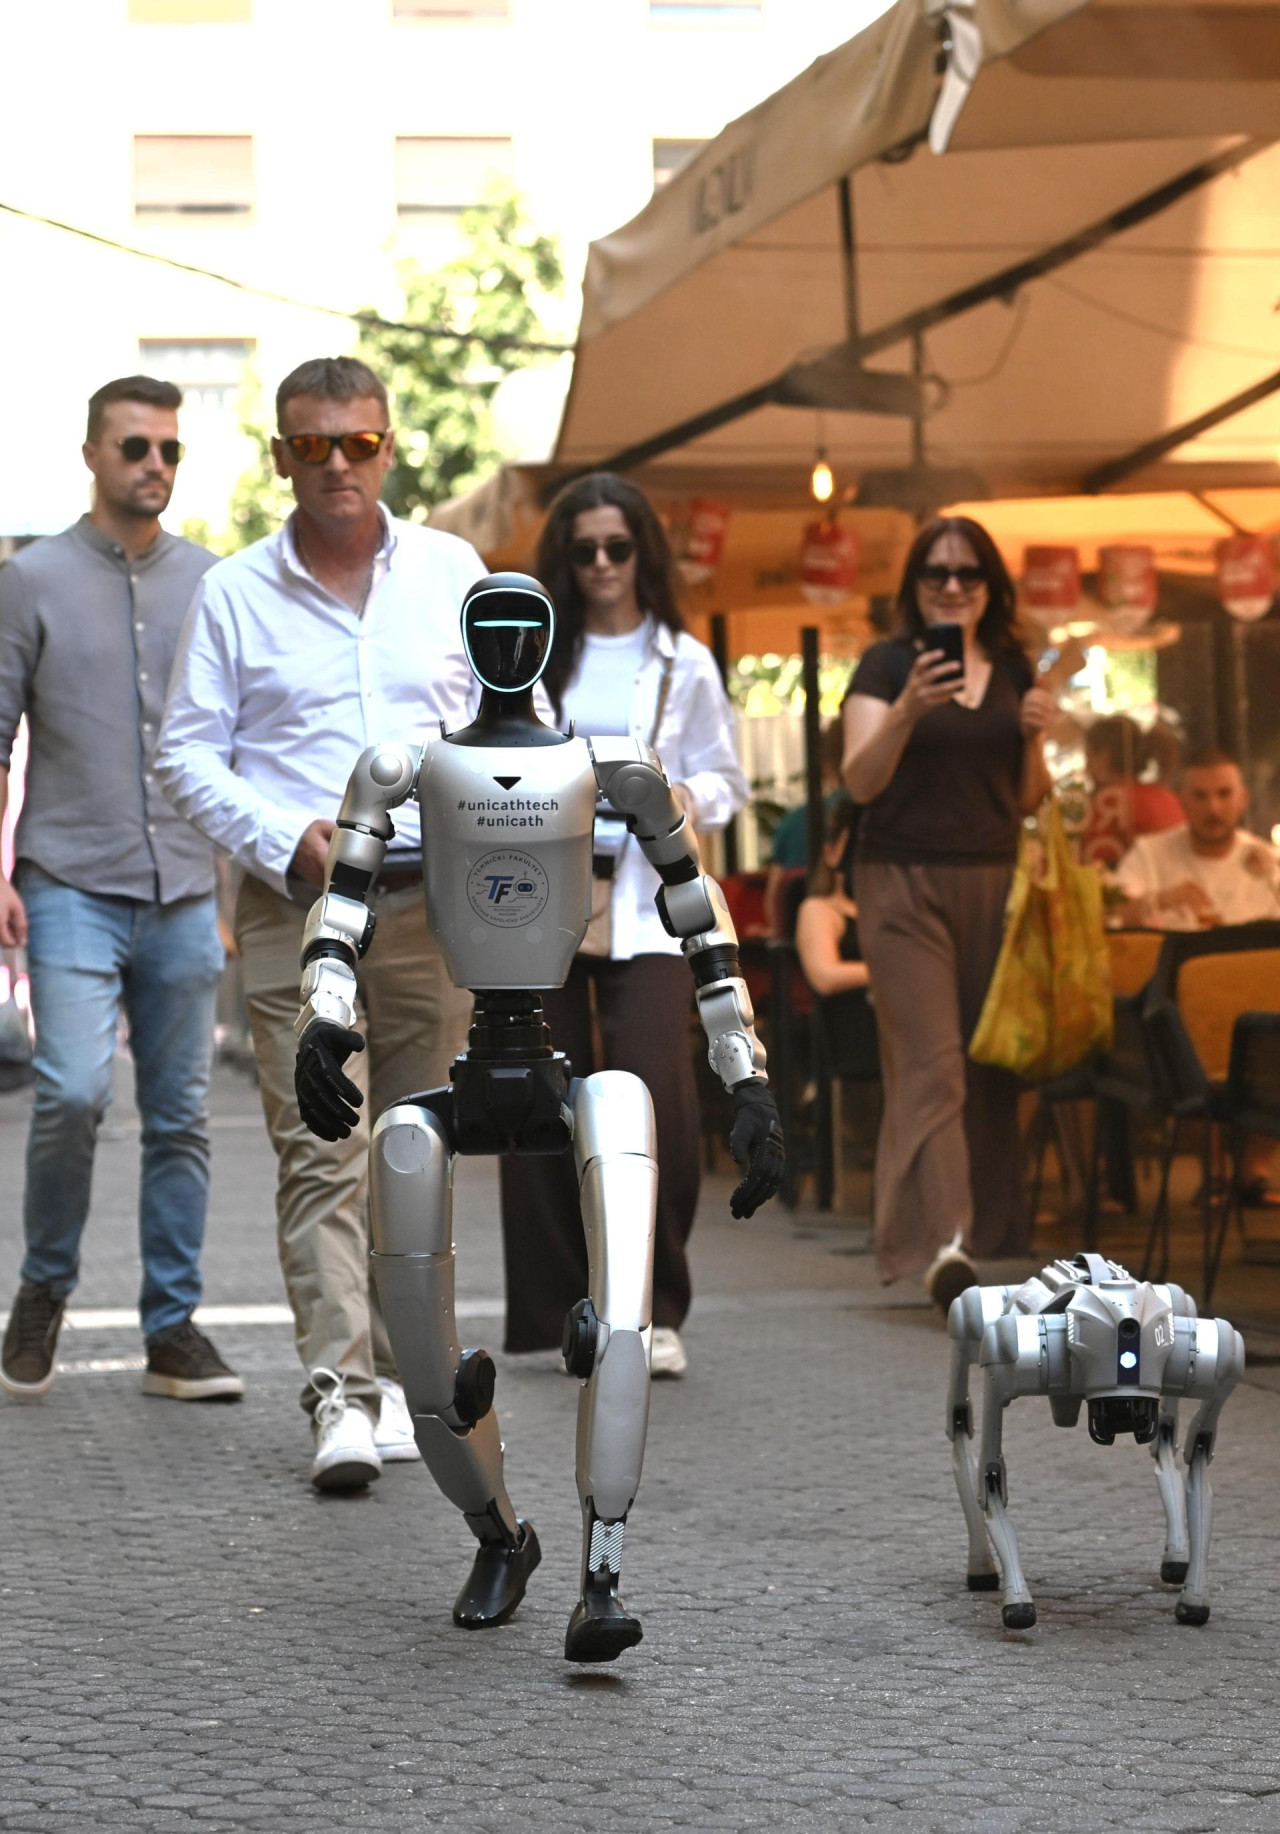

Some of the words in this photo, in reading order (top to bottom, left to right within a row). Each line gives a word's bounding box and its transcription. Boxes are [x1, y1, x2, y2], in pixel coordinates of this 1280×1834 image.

[457, 799, 559, 811] #unicathtech
[477, 815, 544, 827] #unicath
[484, 875, 515, 904] TF
[1154, 1324, 1165, 1347] 02
